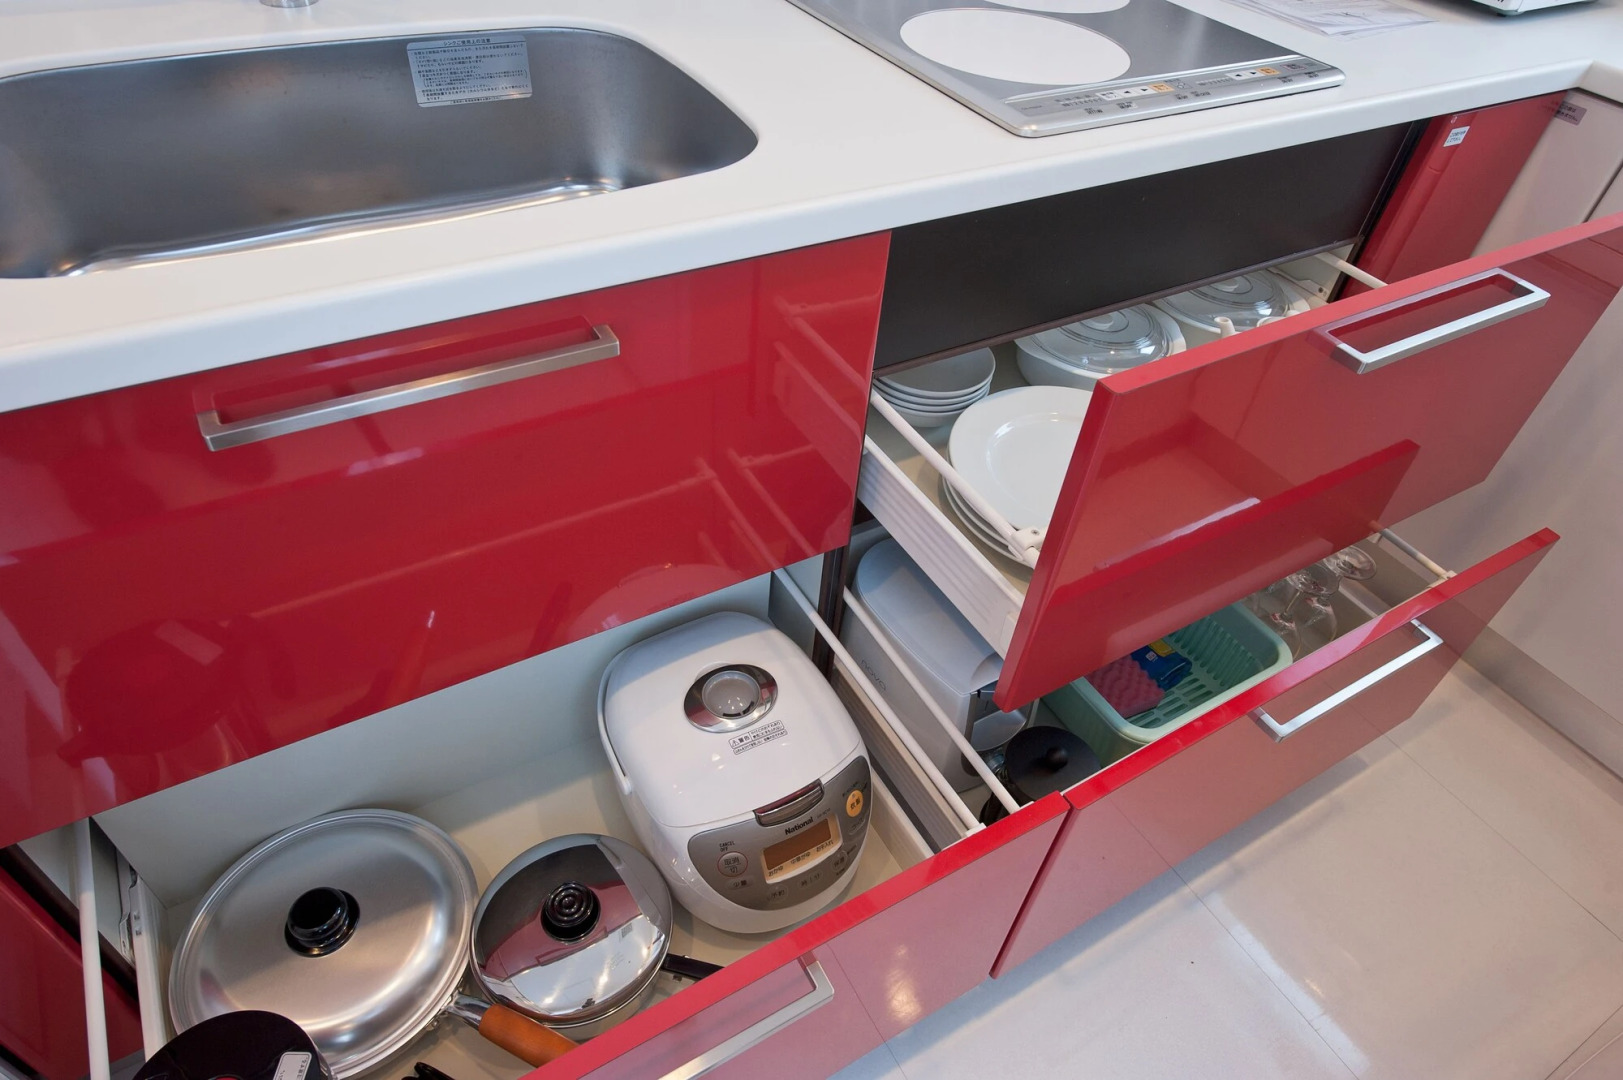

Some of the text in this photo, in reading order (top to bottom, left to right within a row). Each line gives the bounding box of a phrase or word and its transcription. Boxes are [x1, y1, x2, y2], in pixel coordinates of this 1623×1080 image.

[443, 38, 491, 46] シンクご使用上の注意
[785, 817, 814, 835] National
[719, 840, 735, 848] CANCEL
[723, 857, 740, 866] 取消
